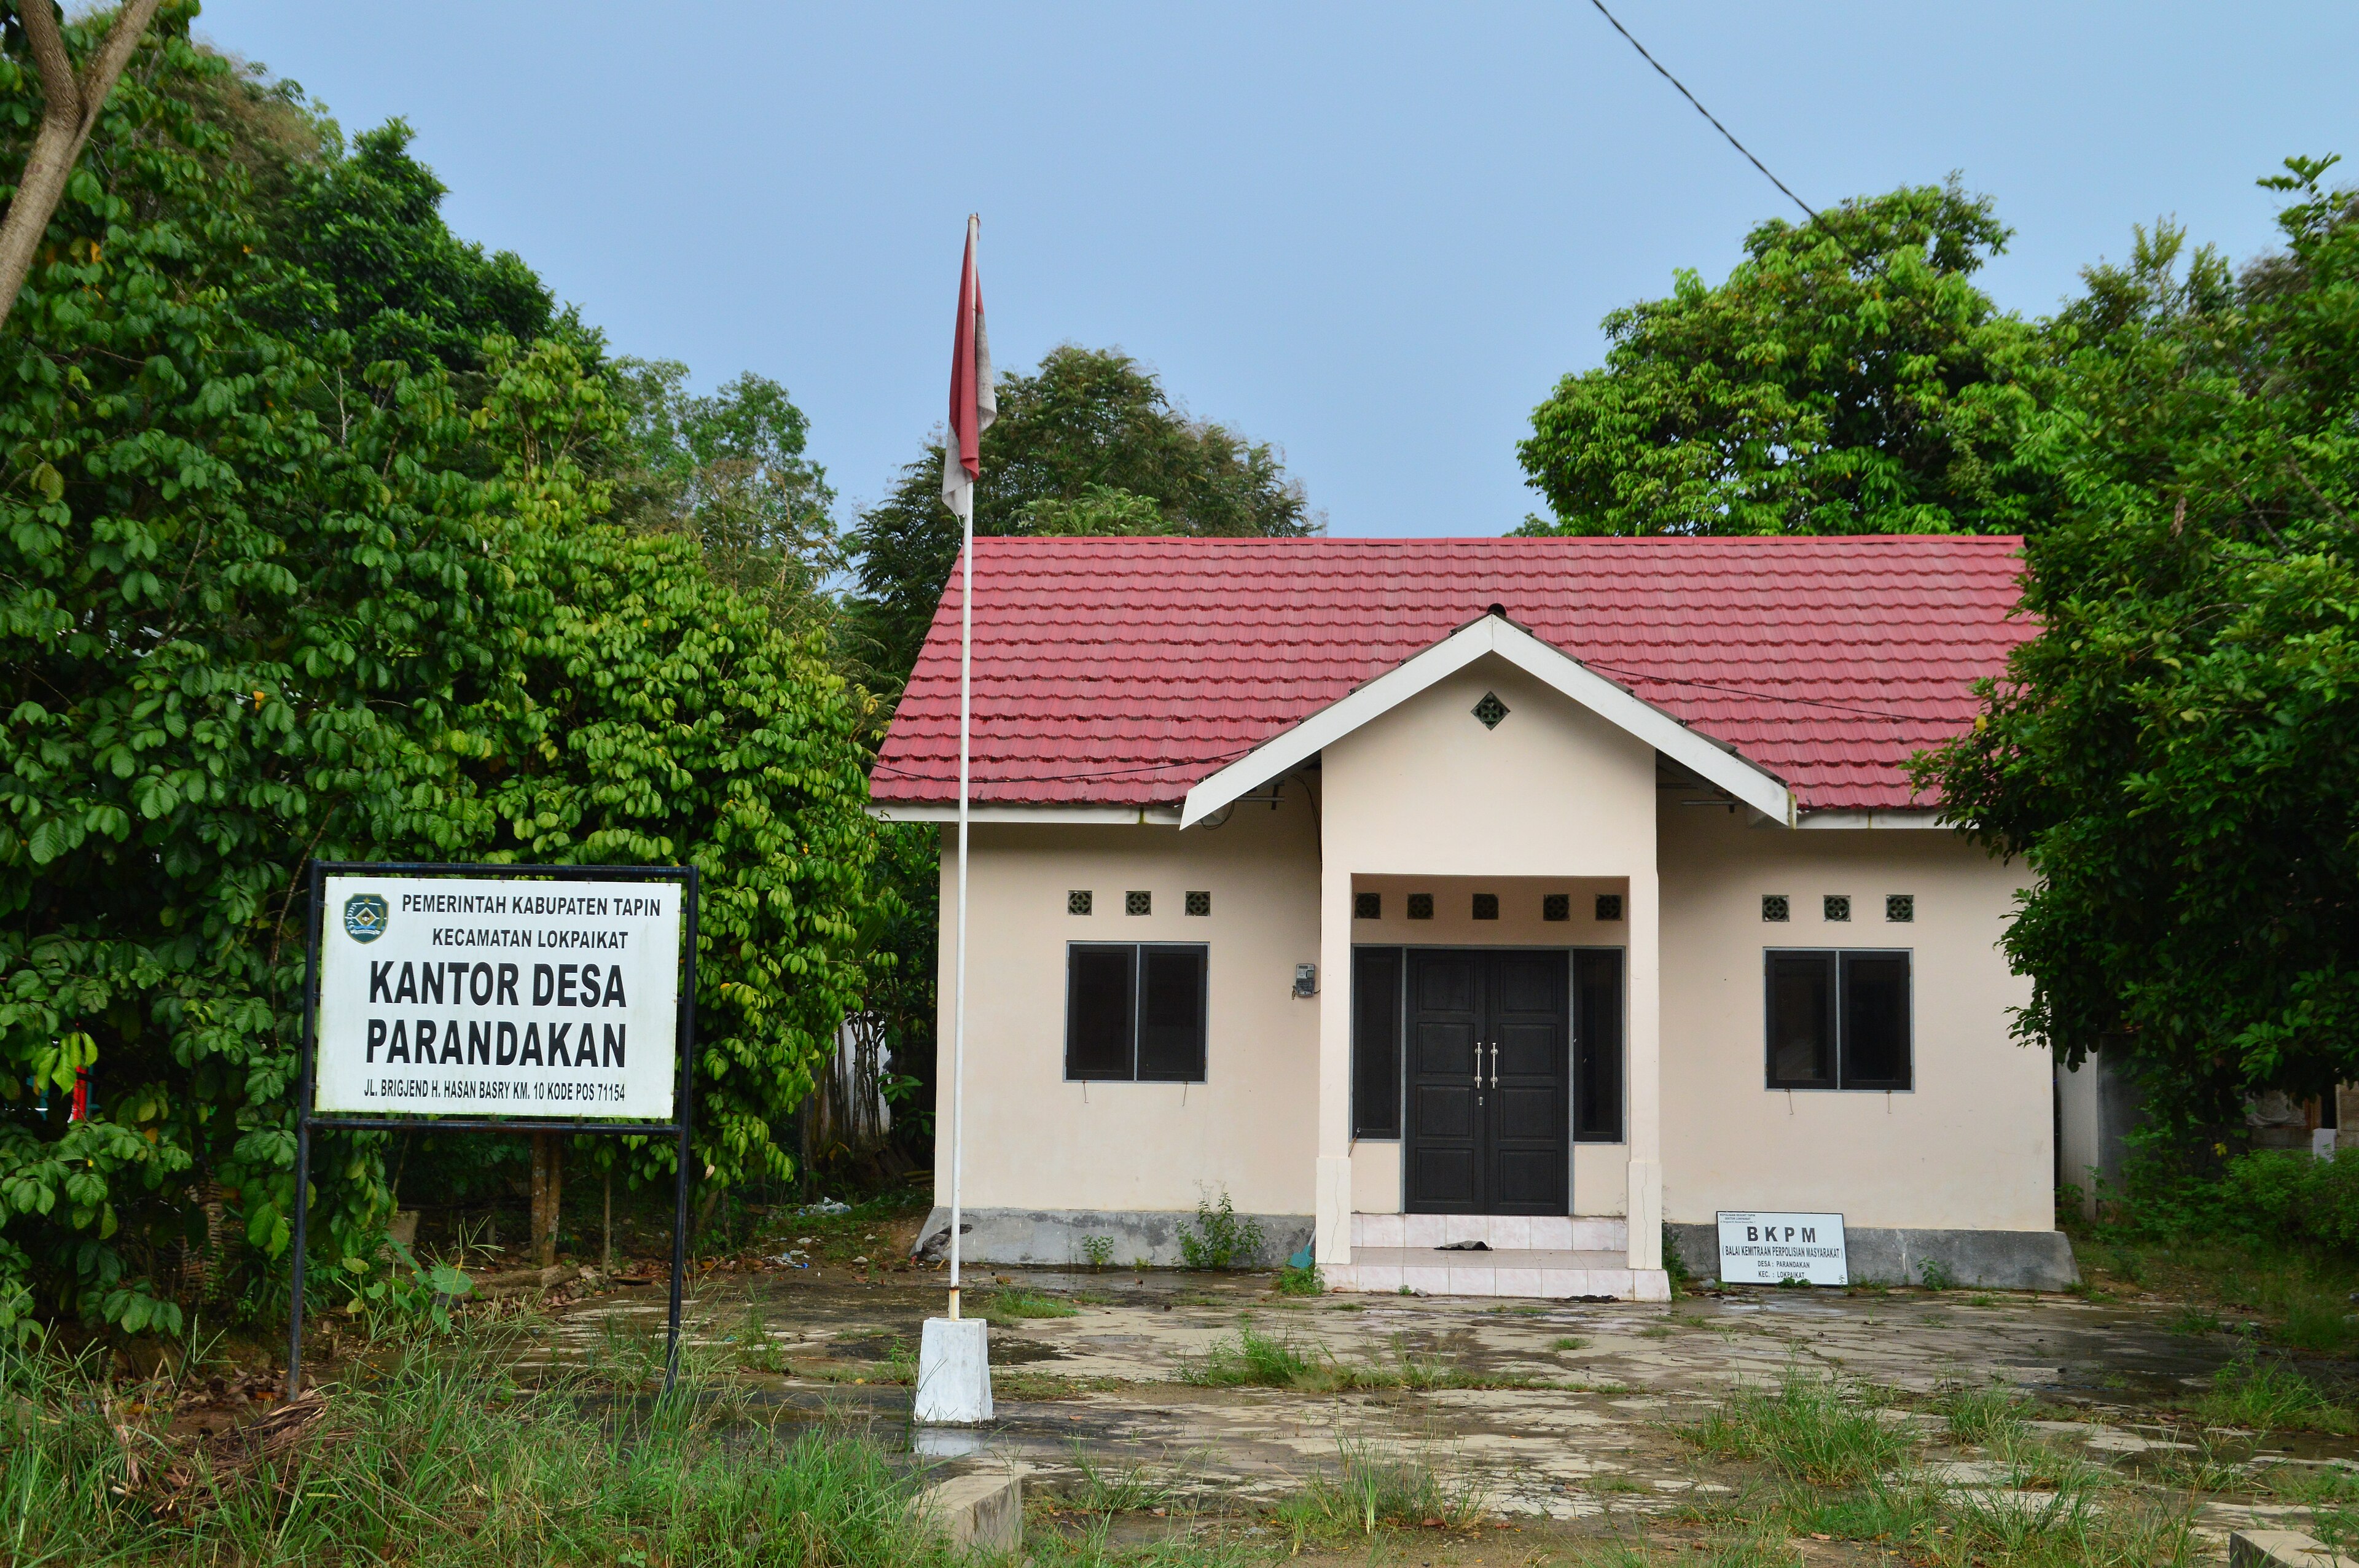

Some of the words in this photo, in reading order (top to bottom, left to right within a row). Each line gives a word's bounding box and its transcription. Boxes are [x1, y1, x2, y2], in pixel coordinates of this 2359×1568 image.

[402, 894, 506, 914] PEMERINTAH
[512, 896, 607, 916] KABUPATEN
[614, 899, 661, 916] TAPIN
[432, 928, 531, 948] KECAMATAN
[538, 930, 628, 949] LOKPAIKAT
[369, 961, 519, 1006] KANTOR
[533, 963, 627, 1008] DESA
[366, 1019, 625, 1067] PARANDAKAN
[364, 1079, 377, 1096] JL.
[381, 1079, 428, 1098] BRIGJEND
[431, 1080, 440, 1098] H.
[444, 1080, 476, 1099] HASAN
[479, 1081, 511, 1099] BASRY
[513, 1082, 530, 1099] KM.
[534, 1082, 544, 1100] 10
[547, 1082, 573, 1100] KODE
[576, 1083, 595, 1101] POS
[598, 1083, 625, 1101] 71154
[1741, 1246, 1771, 1256] KEMITRAAN
[1772, 1246, 1805, 1257] PERPOLISIAN
[1806, 1247, 1839, 1258] MASYARAKAT
